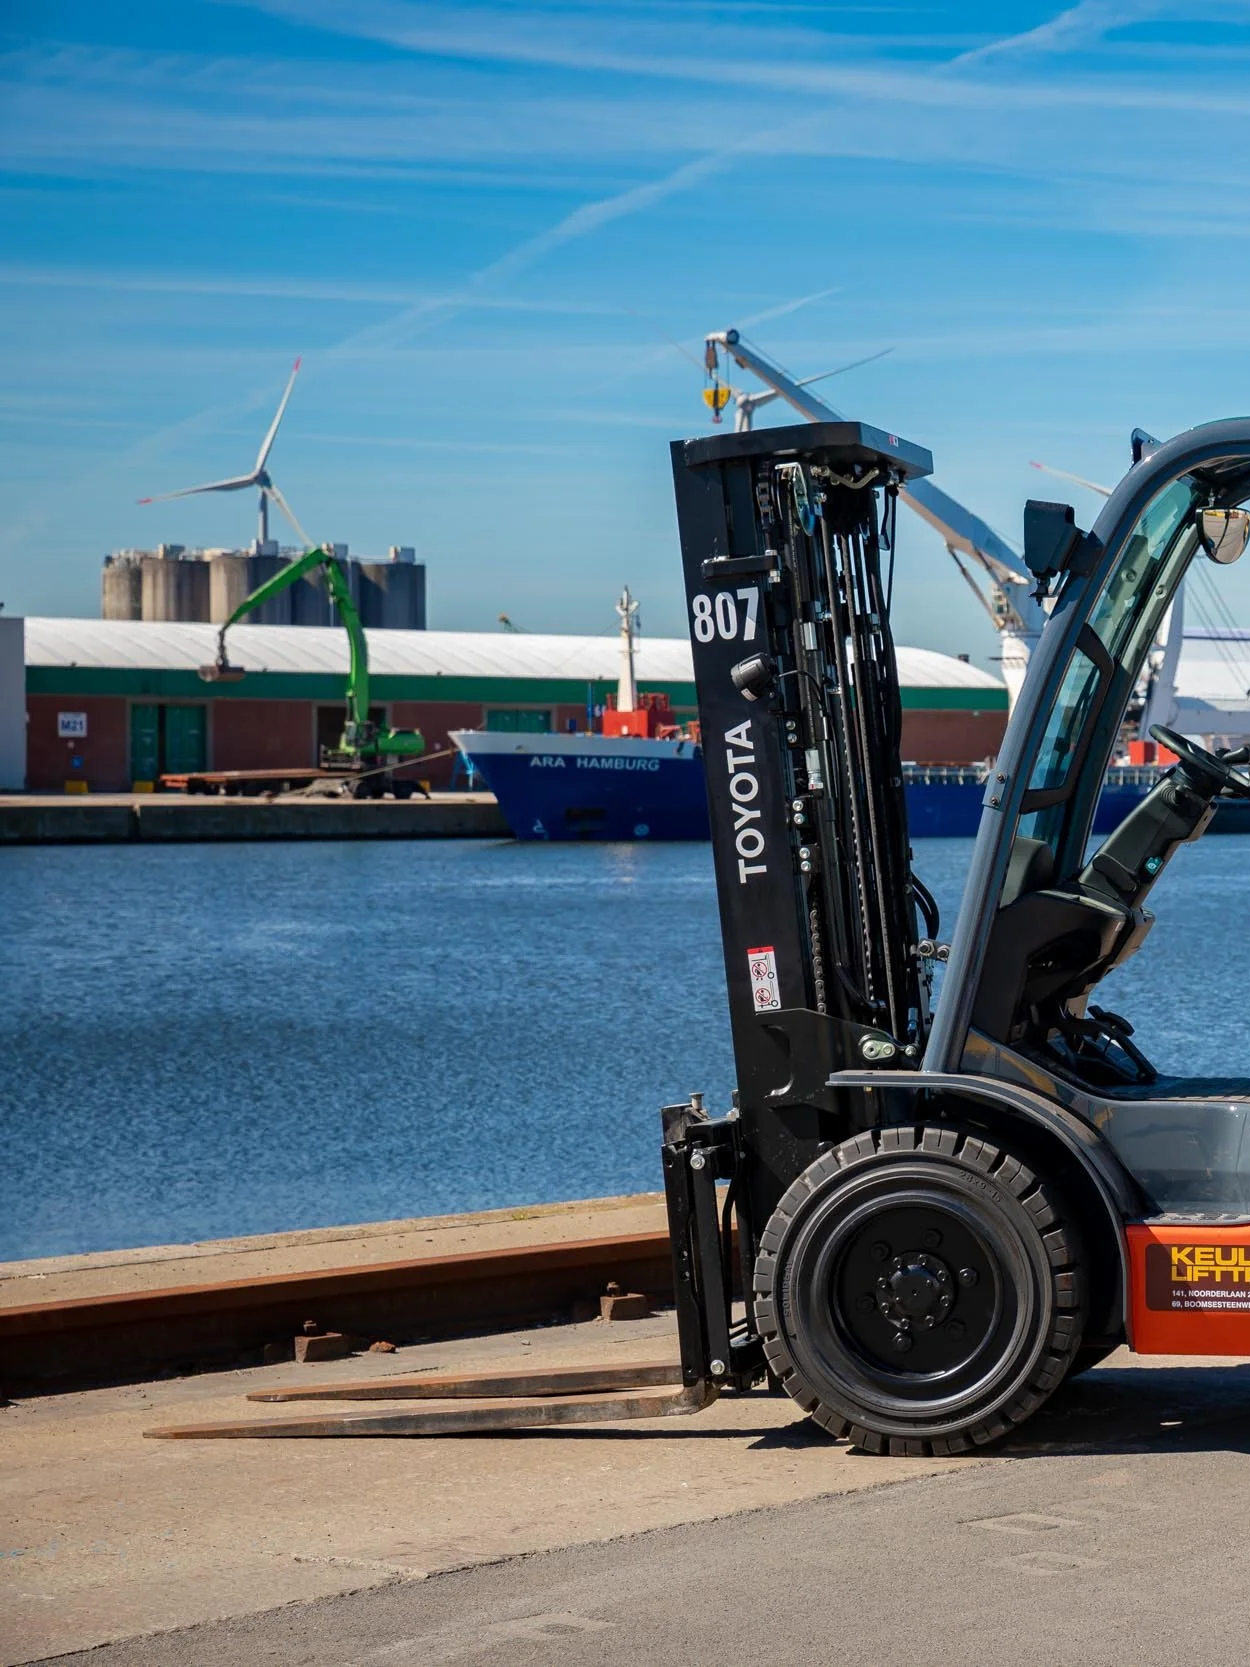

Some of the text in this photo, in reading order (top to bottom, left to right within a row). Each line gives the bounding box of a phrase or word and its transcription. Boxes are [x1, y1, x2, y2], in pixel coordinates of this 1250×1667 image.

[692, 586, 760, 643] 807
[530, 756, 660, 771] ARA HAMBURG
[724, 719, 768, 884] TOYOTA
[1171, 1290, 1187, 1299] 141,
[1188, 1290, 1246, 1298] NOORDERLAAN
